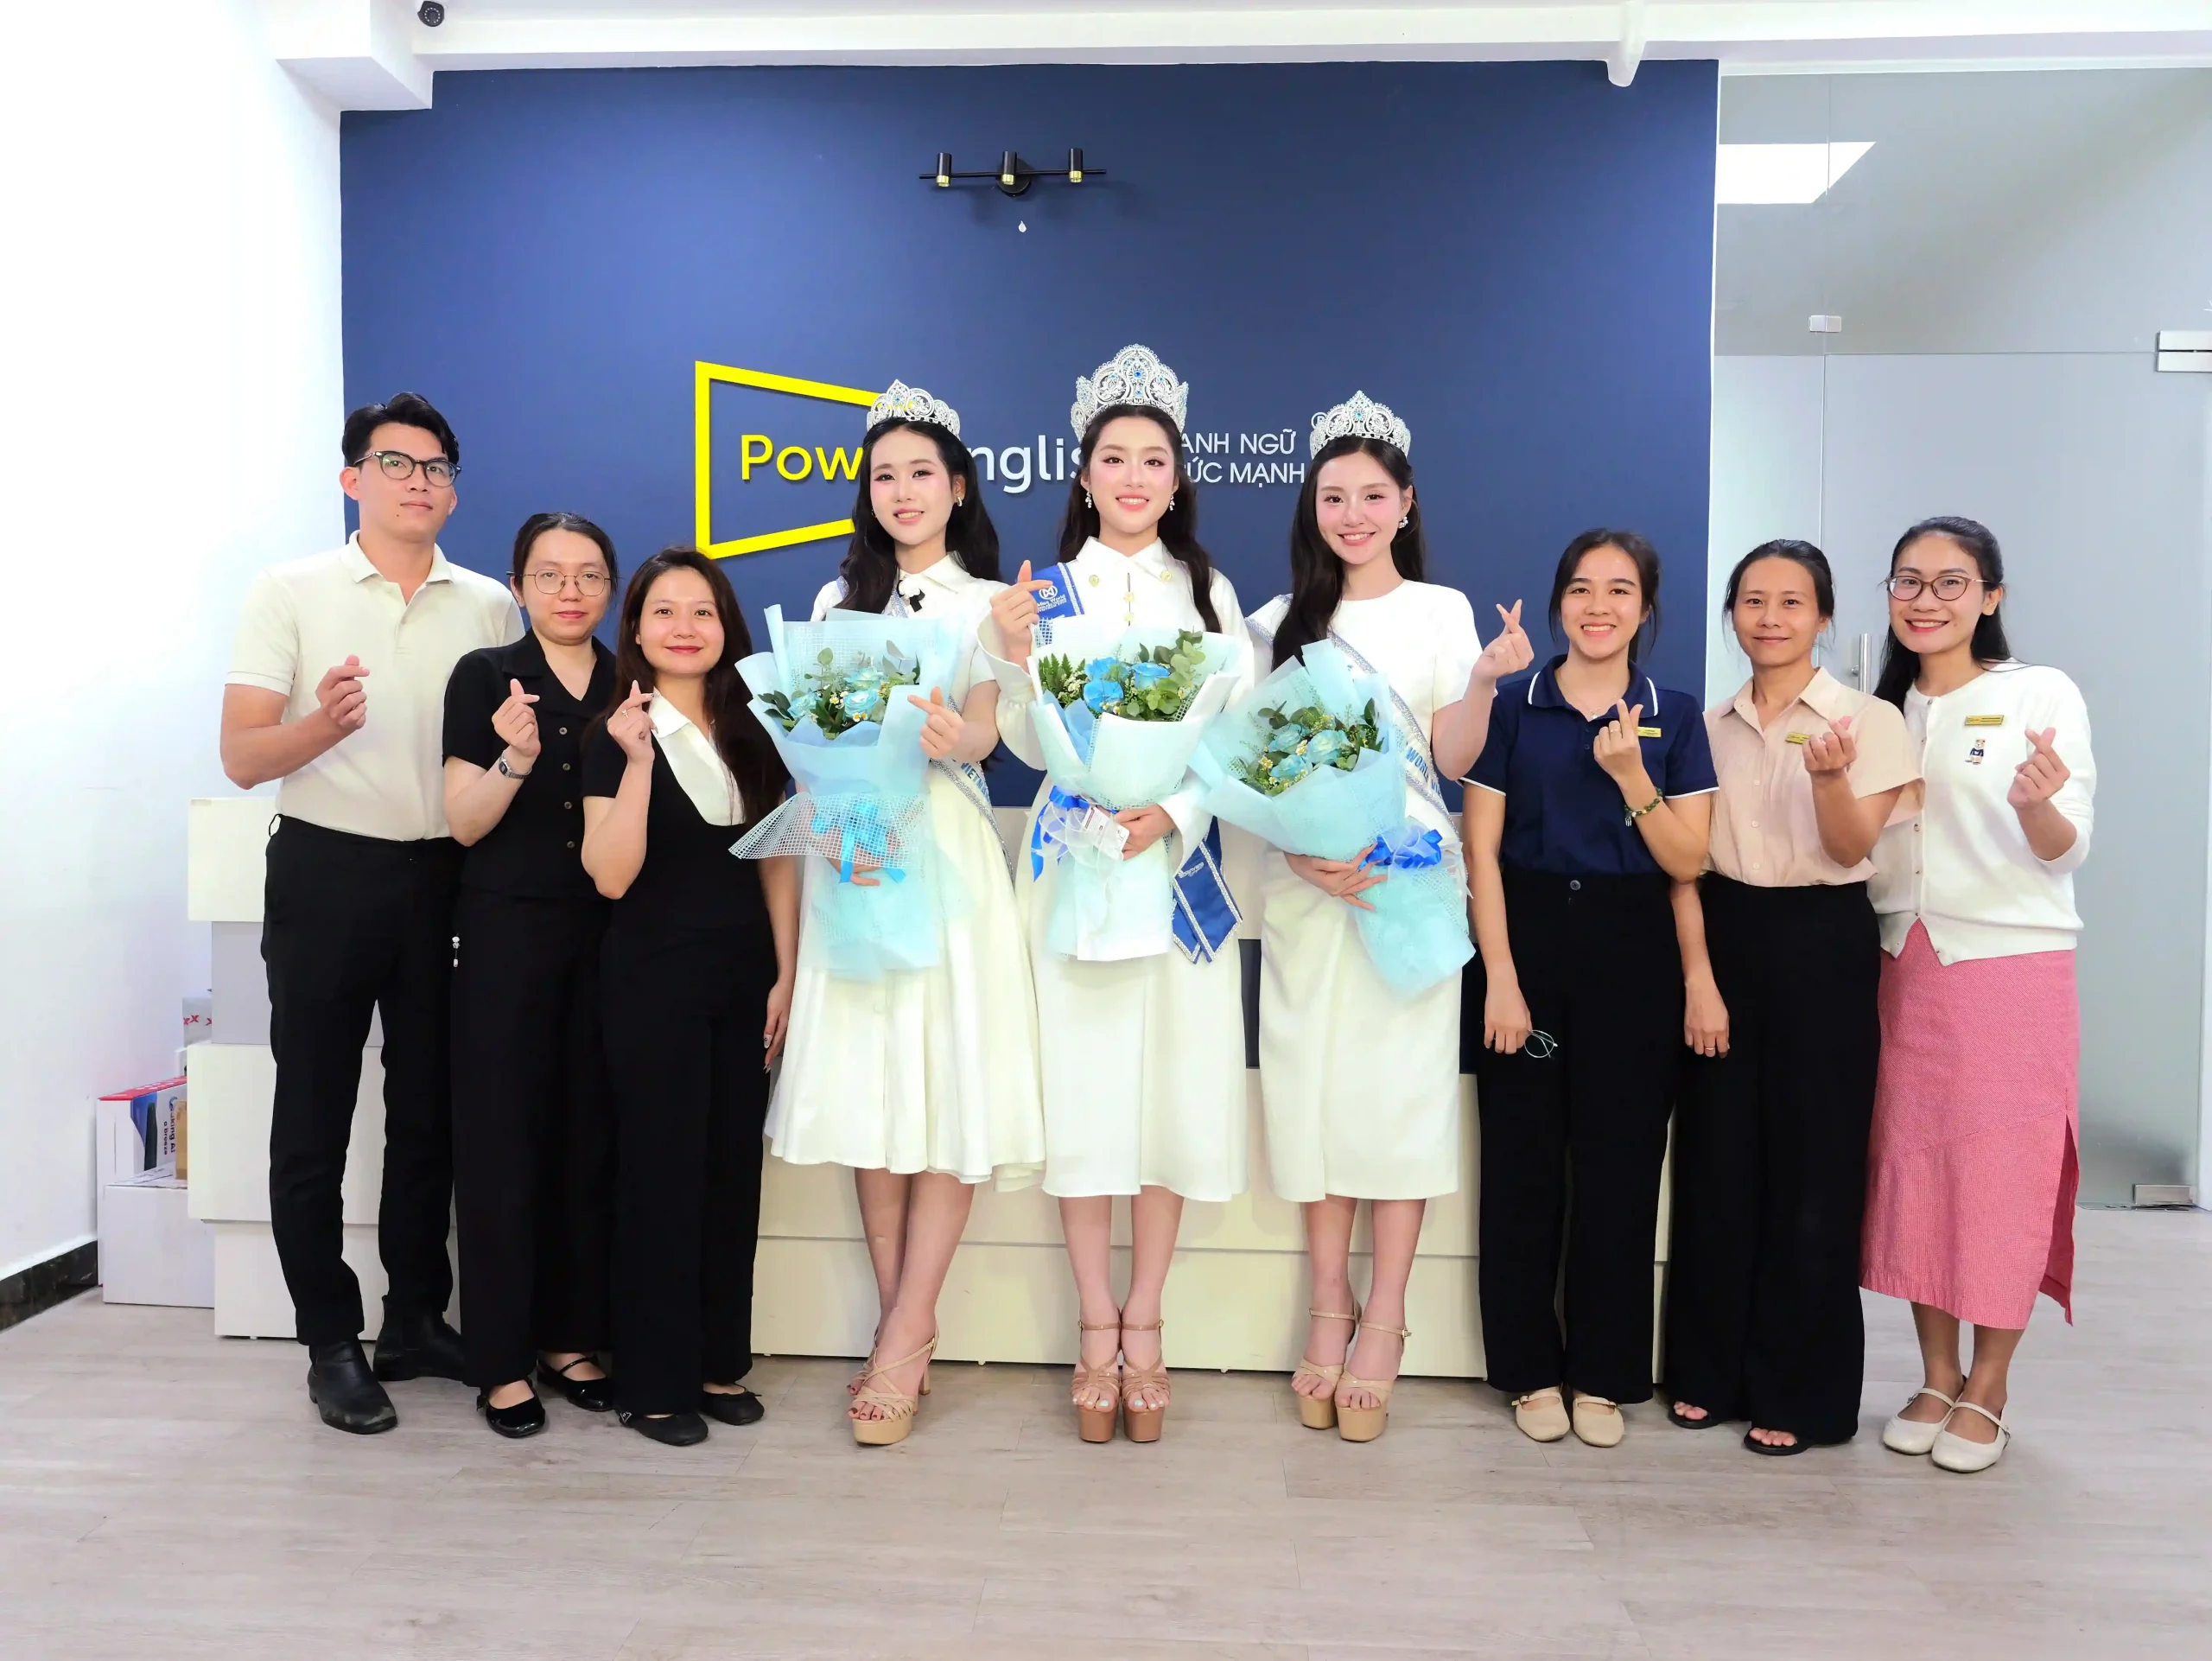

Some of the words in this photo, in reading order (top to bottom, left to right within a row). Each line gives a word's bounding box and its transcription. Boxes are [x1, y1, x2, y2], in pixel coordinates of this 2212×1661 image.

[1240, 429, 1296, 454] NGỮ
[741, 435, 863, 480] Pow
[1185, 456, 1222, 483] ỨC
[1230, 462, 1305, 487] MẠNH
